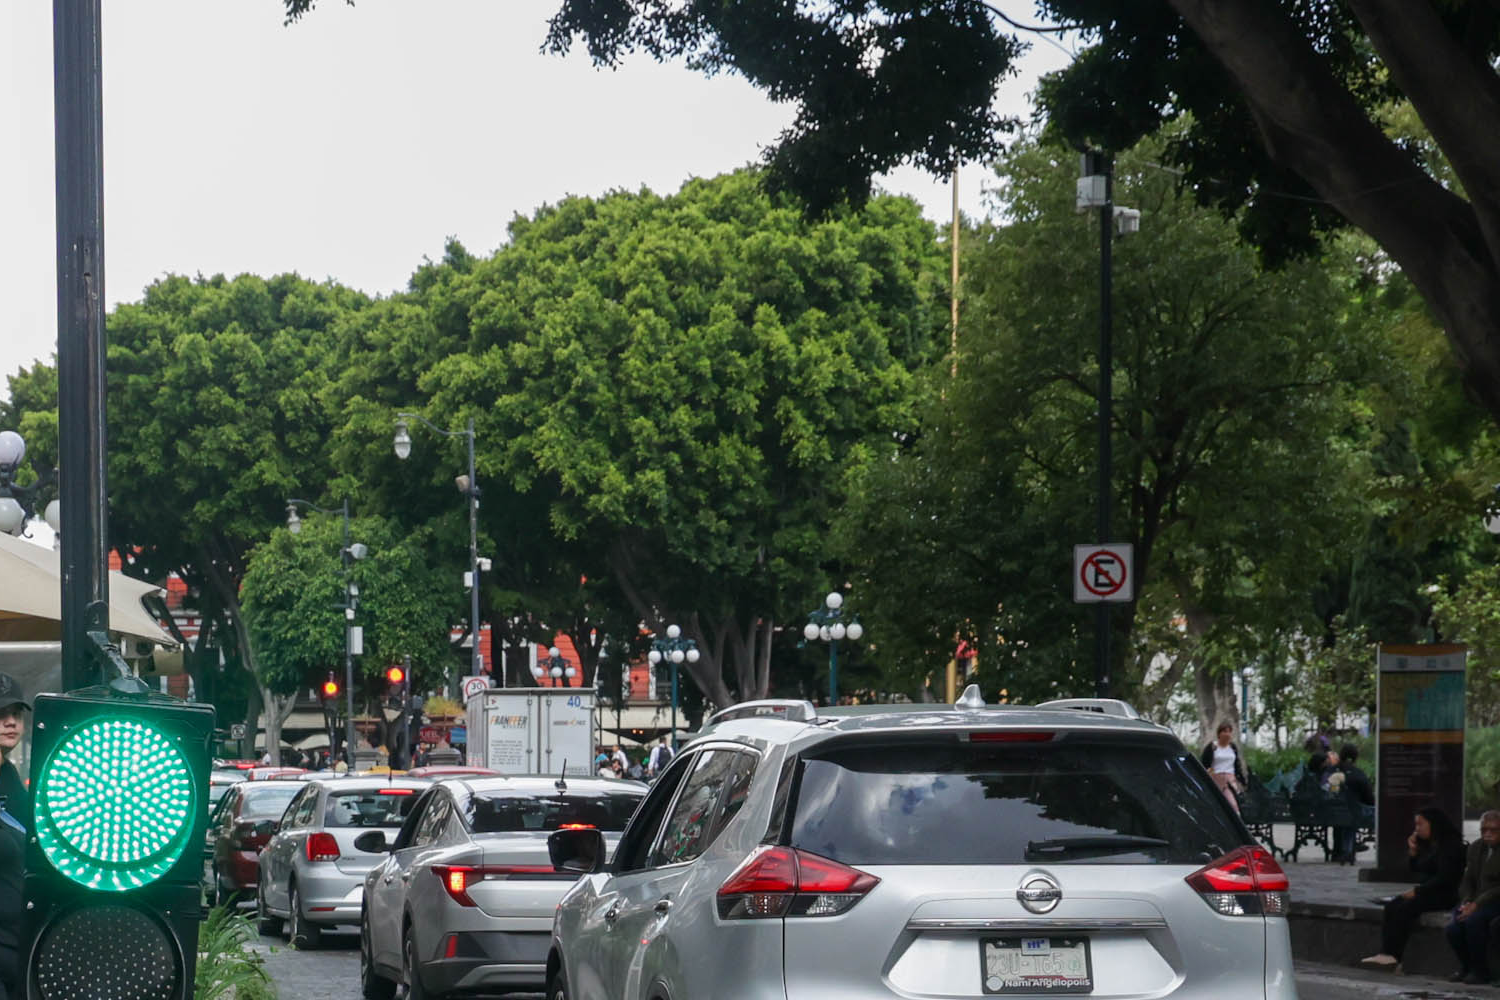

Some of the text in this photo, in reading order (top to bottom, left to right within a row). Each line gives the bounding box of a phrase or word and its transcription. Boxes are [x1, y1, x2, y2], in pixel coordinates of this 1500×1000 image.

[1094, 558, 1116, 588] E
[471, 682, 482, 690] 30
[567, 696, 581, 707] 40
[1020, 891, 1061, 899] NISSAN
